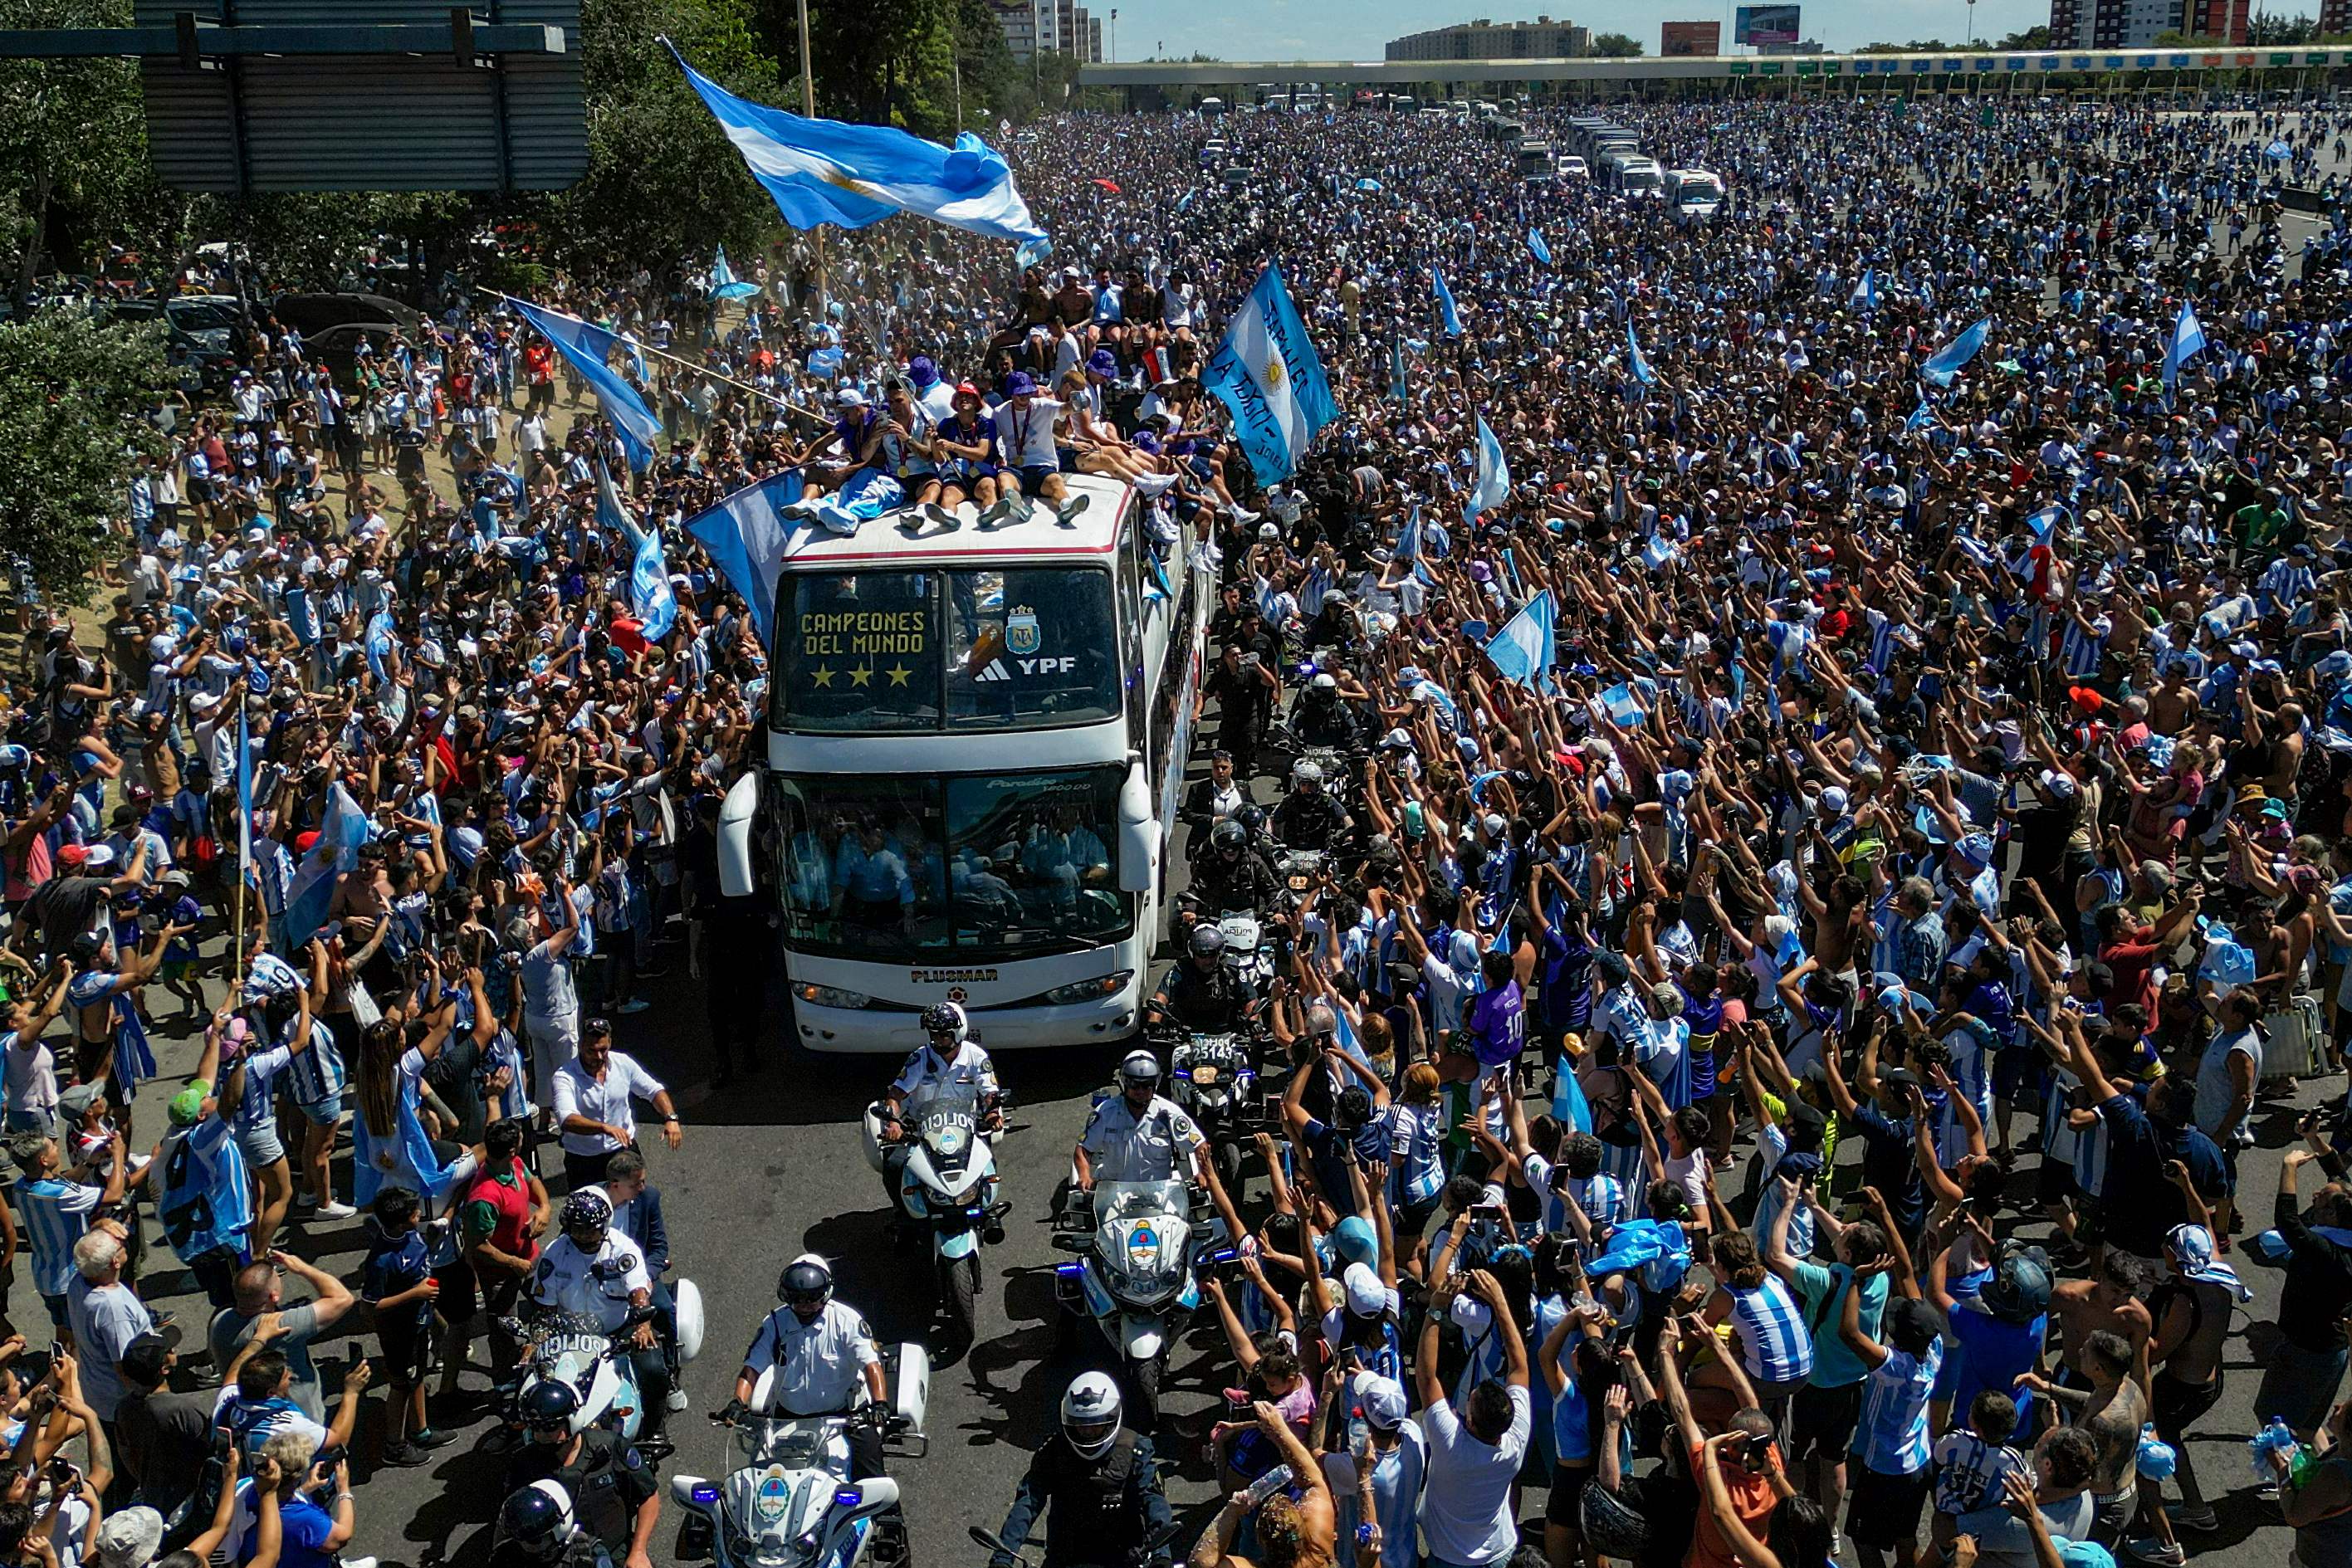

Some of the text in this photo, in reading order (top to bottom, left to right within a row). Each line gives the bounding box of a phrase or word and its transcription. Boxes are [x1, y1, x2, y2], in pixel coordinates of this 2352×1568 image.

[1210, 344, 1237, 379] LA
[802, 612, 924, 633] CAMPEONES
[805, 633, 924, 655] DEL MUNDO
[1017, 657, 1075, 675] YPF
[986, 778, 1057, 789] Paradiso
[911, 969, 998, 983] PLUSMAR
[1505, 1011, 1523, 1044] 10
[1193, 1046, 1232, 1061] 25143
[1578, 1201, 1600, 1212] ESSI
